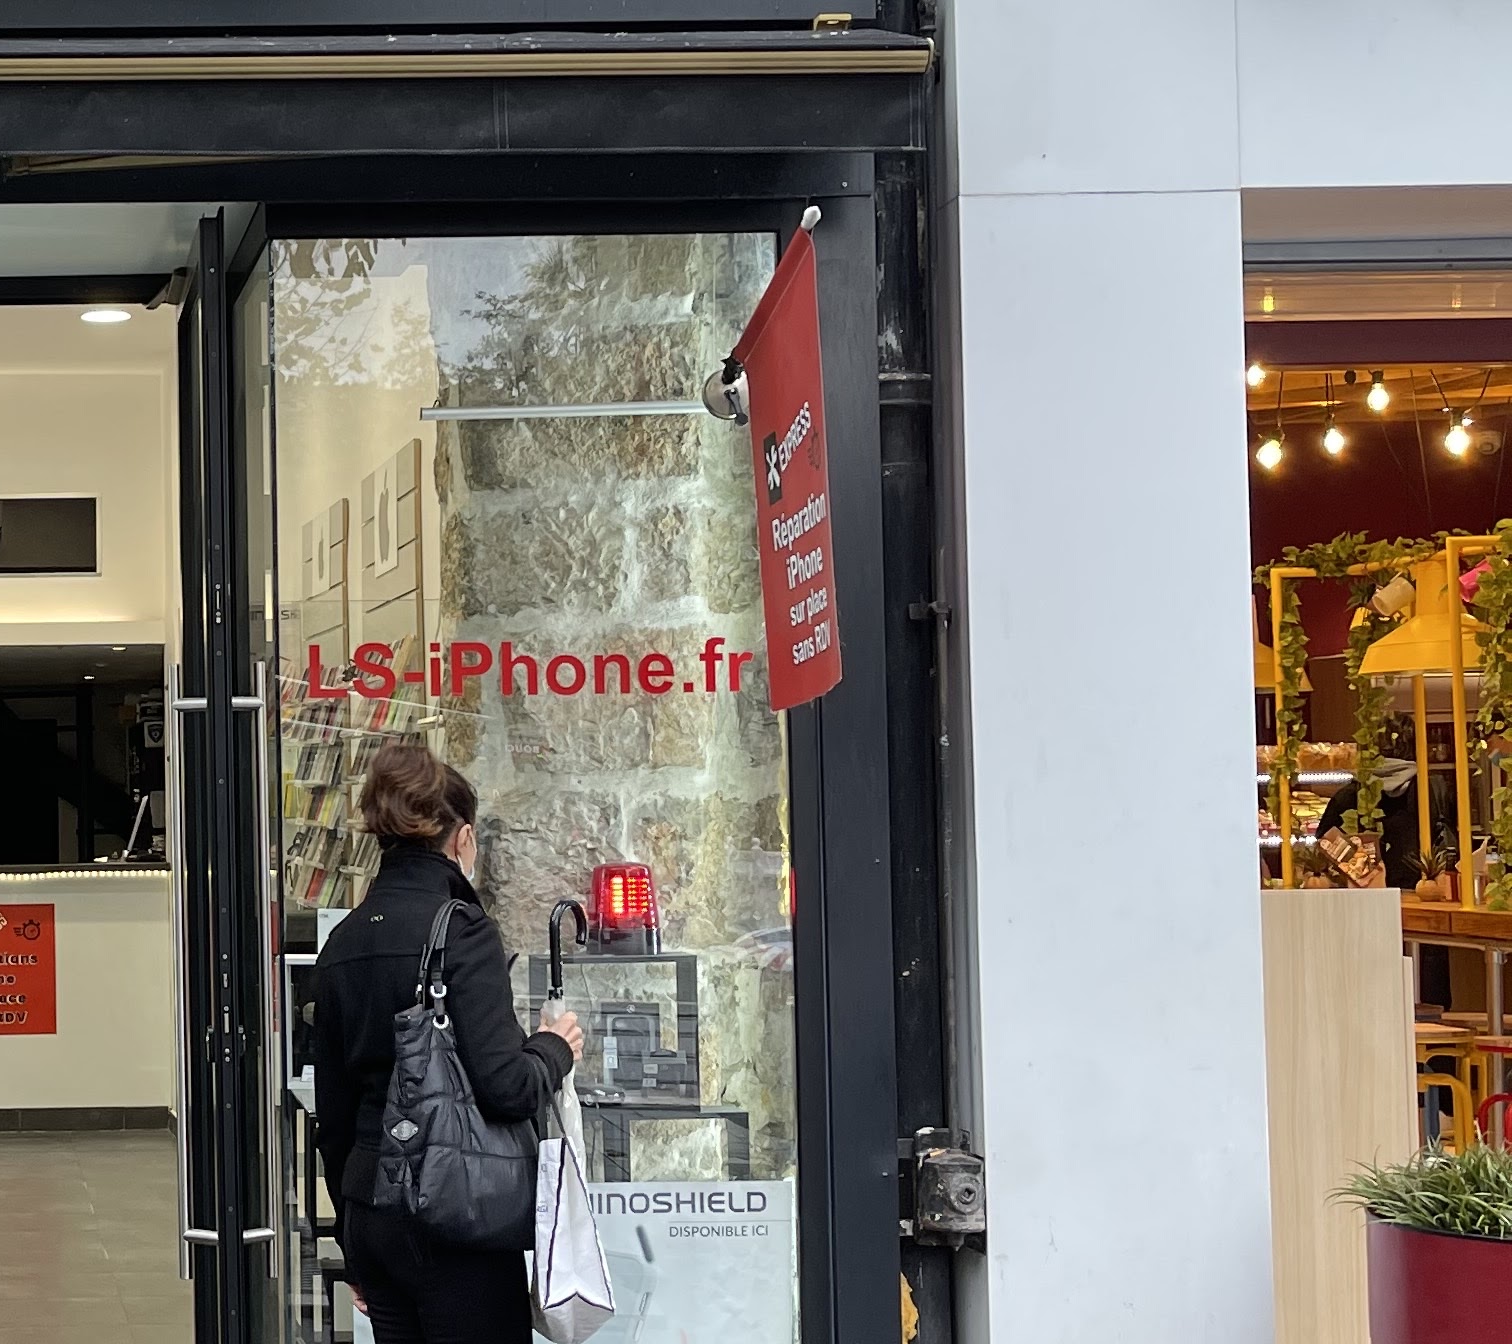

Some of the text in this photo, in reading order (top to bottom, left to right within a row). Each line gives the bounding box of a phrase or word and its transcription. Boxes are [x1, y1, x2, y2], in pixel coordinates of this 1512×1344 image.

[778, 401, 812, 472] EXPRESS
[772, 492, 826, 552] Réparation
[786, 546, 823, 590] iPhone
[789, 586, 828, 627] sur place
[792, 617, 832, 665] sans RDV
[307, 637, 754, 699] LS-iPhone.fr
[589, 1191, 767, 1215] INOSHIELD
[669, 1223, 769, 1238] DISPONIBLE ICI
